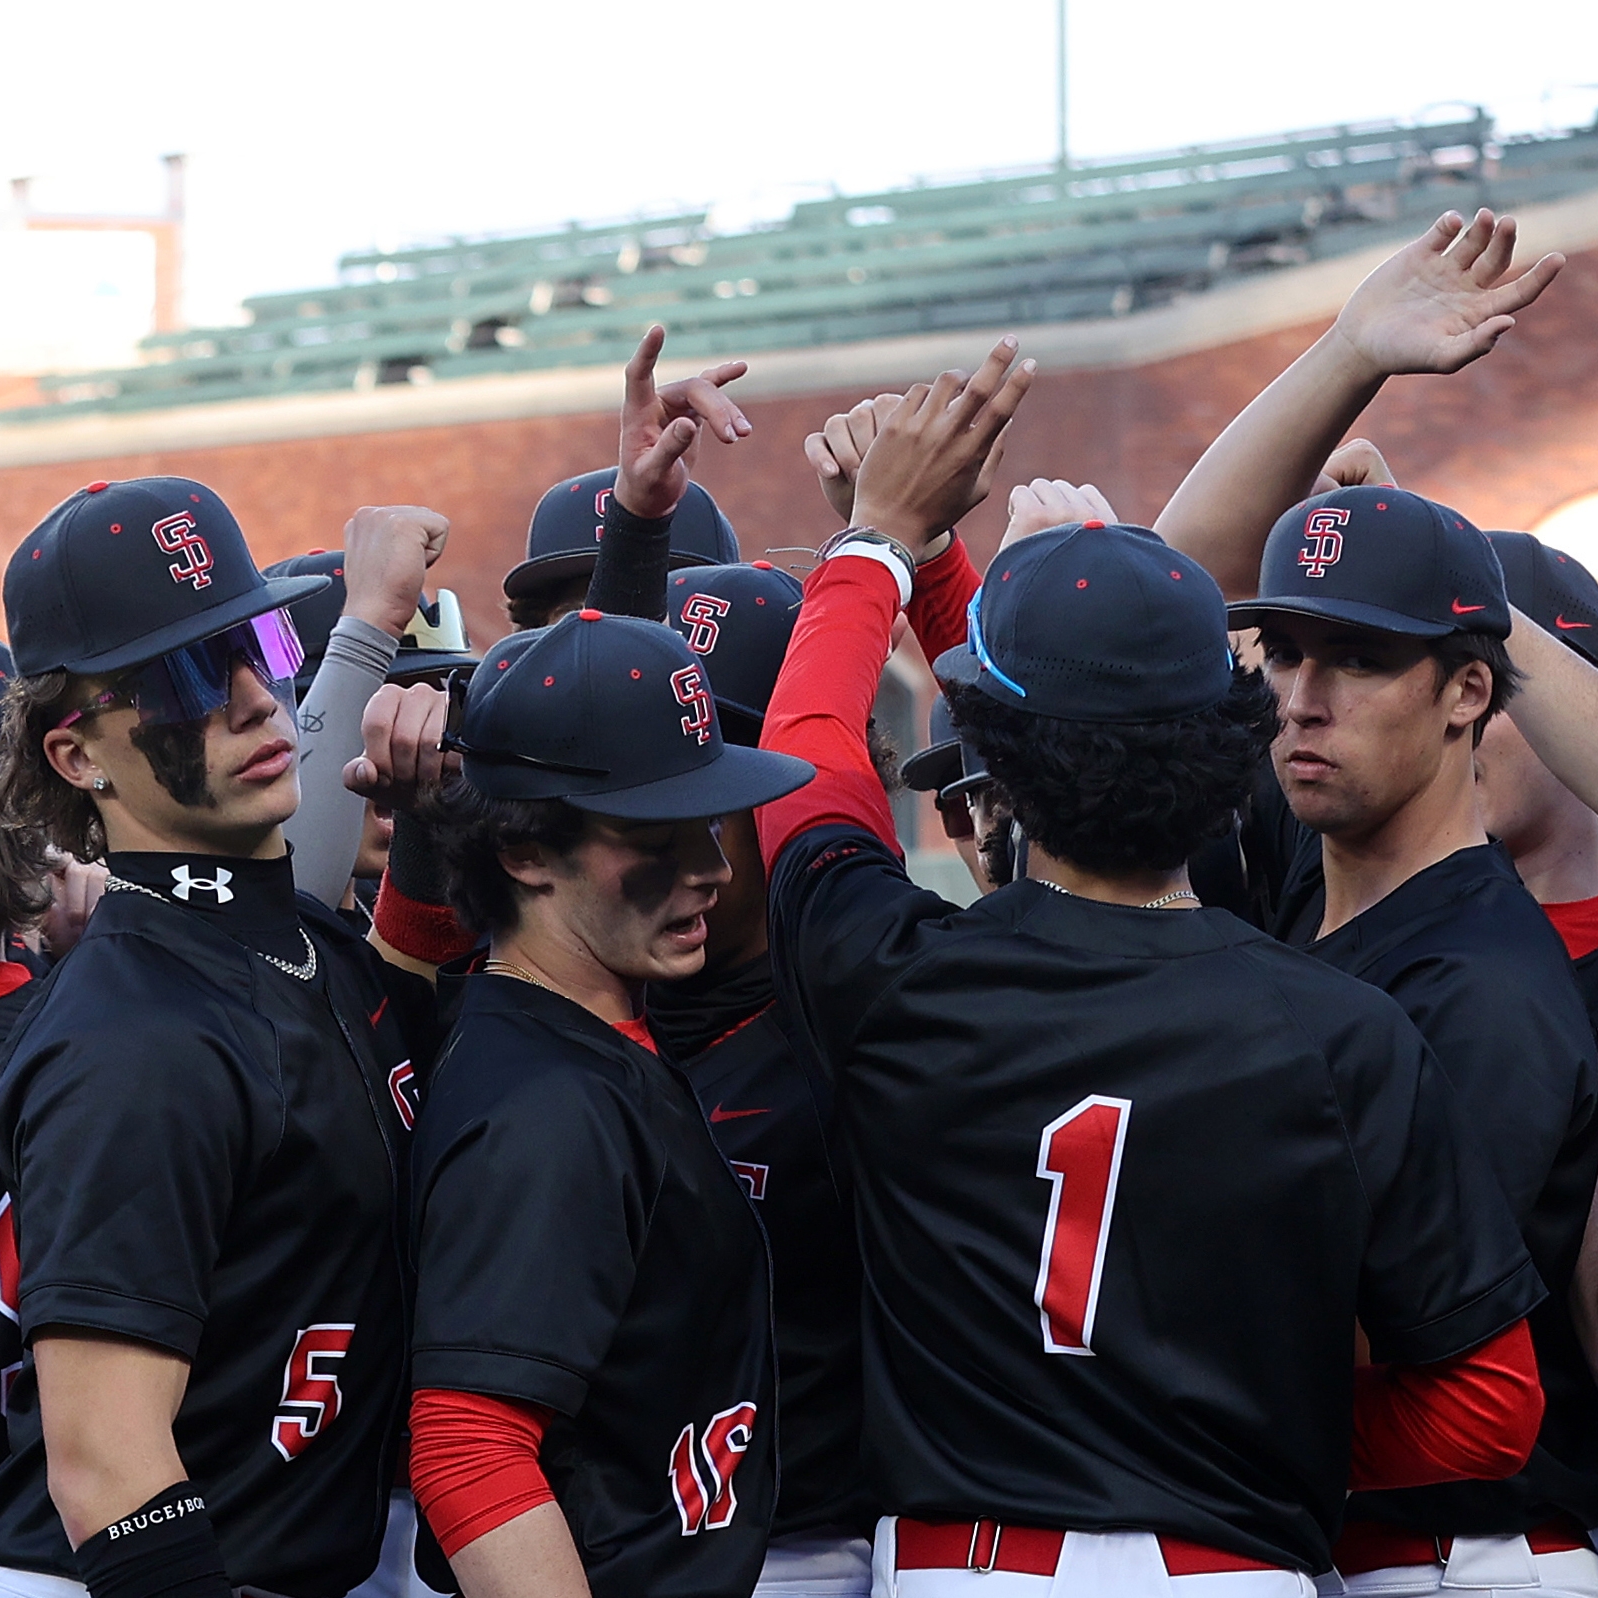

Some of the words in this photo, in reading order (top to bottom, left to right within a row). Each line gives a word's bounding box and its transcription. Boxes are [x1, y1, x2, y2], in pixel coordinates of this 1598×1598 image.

[1034, 1094, 1132, 1356] 1
[271, 1323, 357, 1463] 5
[107, 1504, 177, 1540] BRUCE
